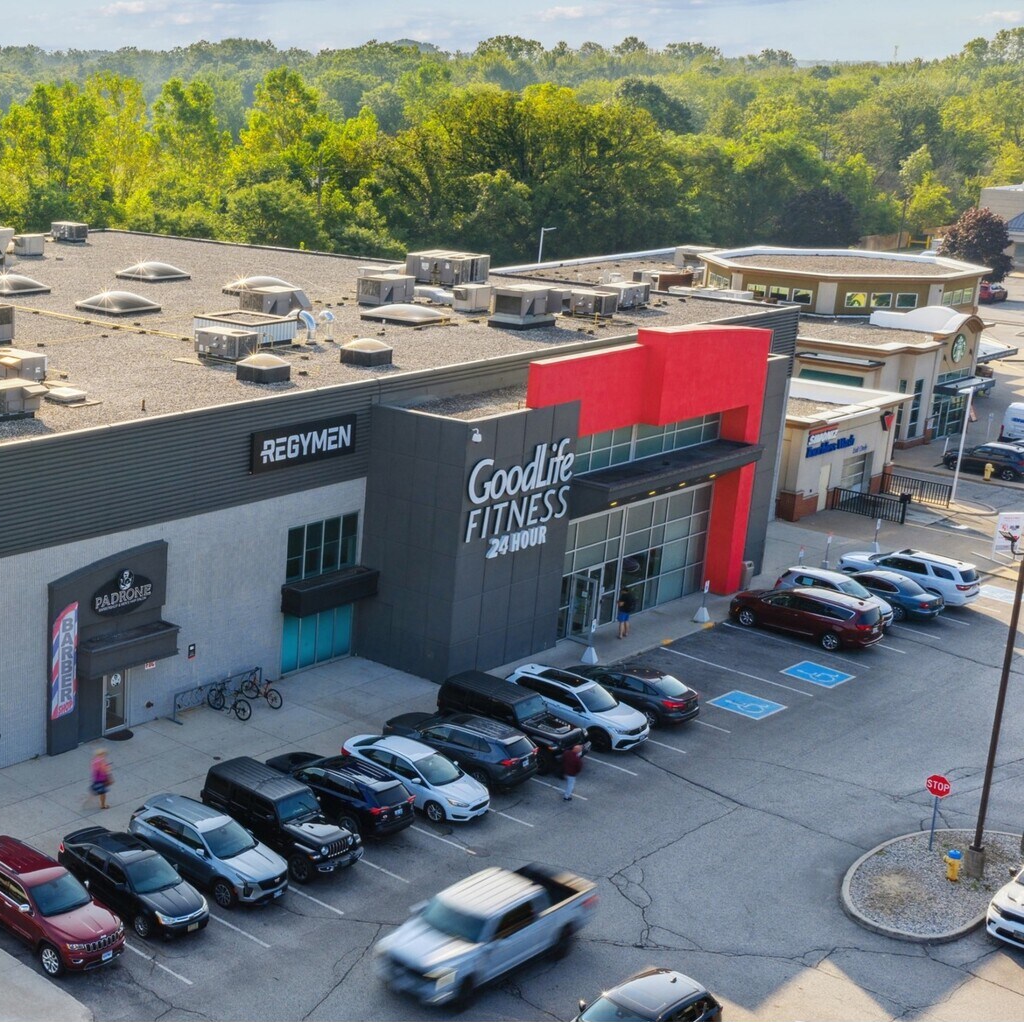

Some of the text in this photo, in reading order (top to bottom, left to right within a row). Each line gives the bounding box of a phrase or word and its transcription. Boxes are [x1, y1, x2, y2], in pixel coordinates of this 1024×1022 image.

[260, 424, 351, 464] REGYMEN
[468, 438, 575, 504] GoodLife
[465, 485, 570, 543] FITNESS
[486, 525, 547, 559] 24 HOUR
[95, 583, 152, 610] PADRONE
[60, 617, 74, 702] BARBER
[927, 779, 950, 792] STOP
